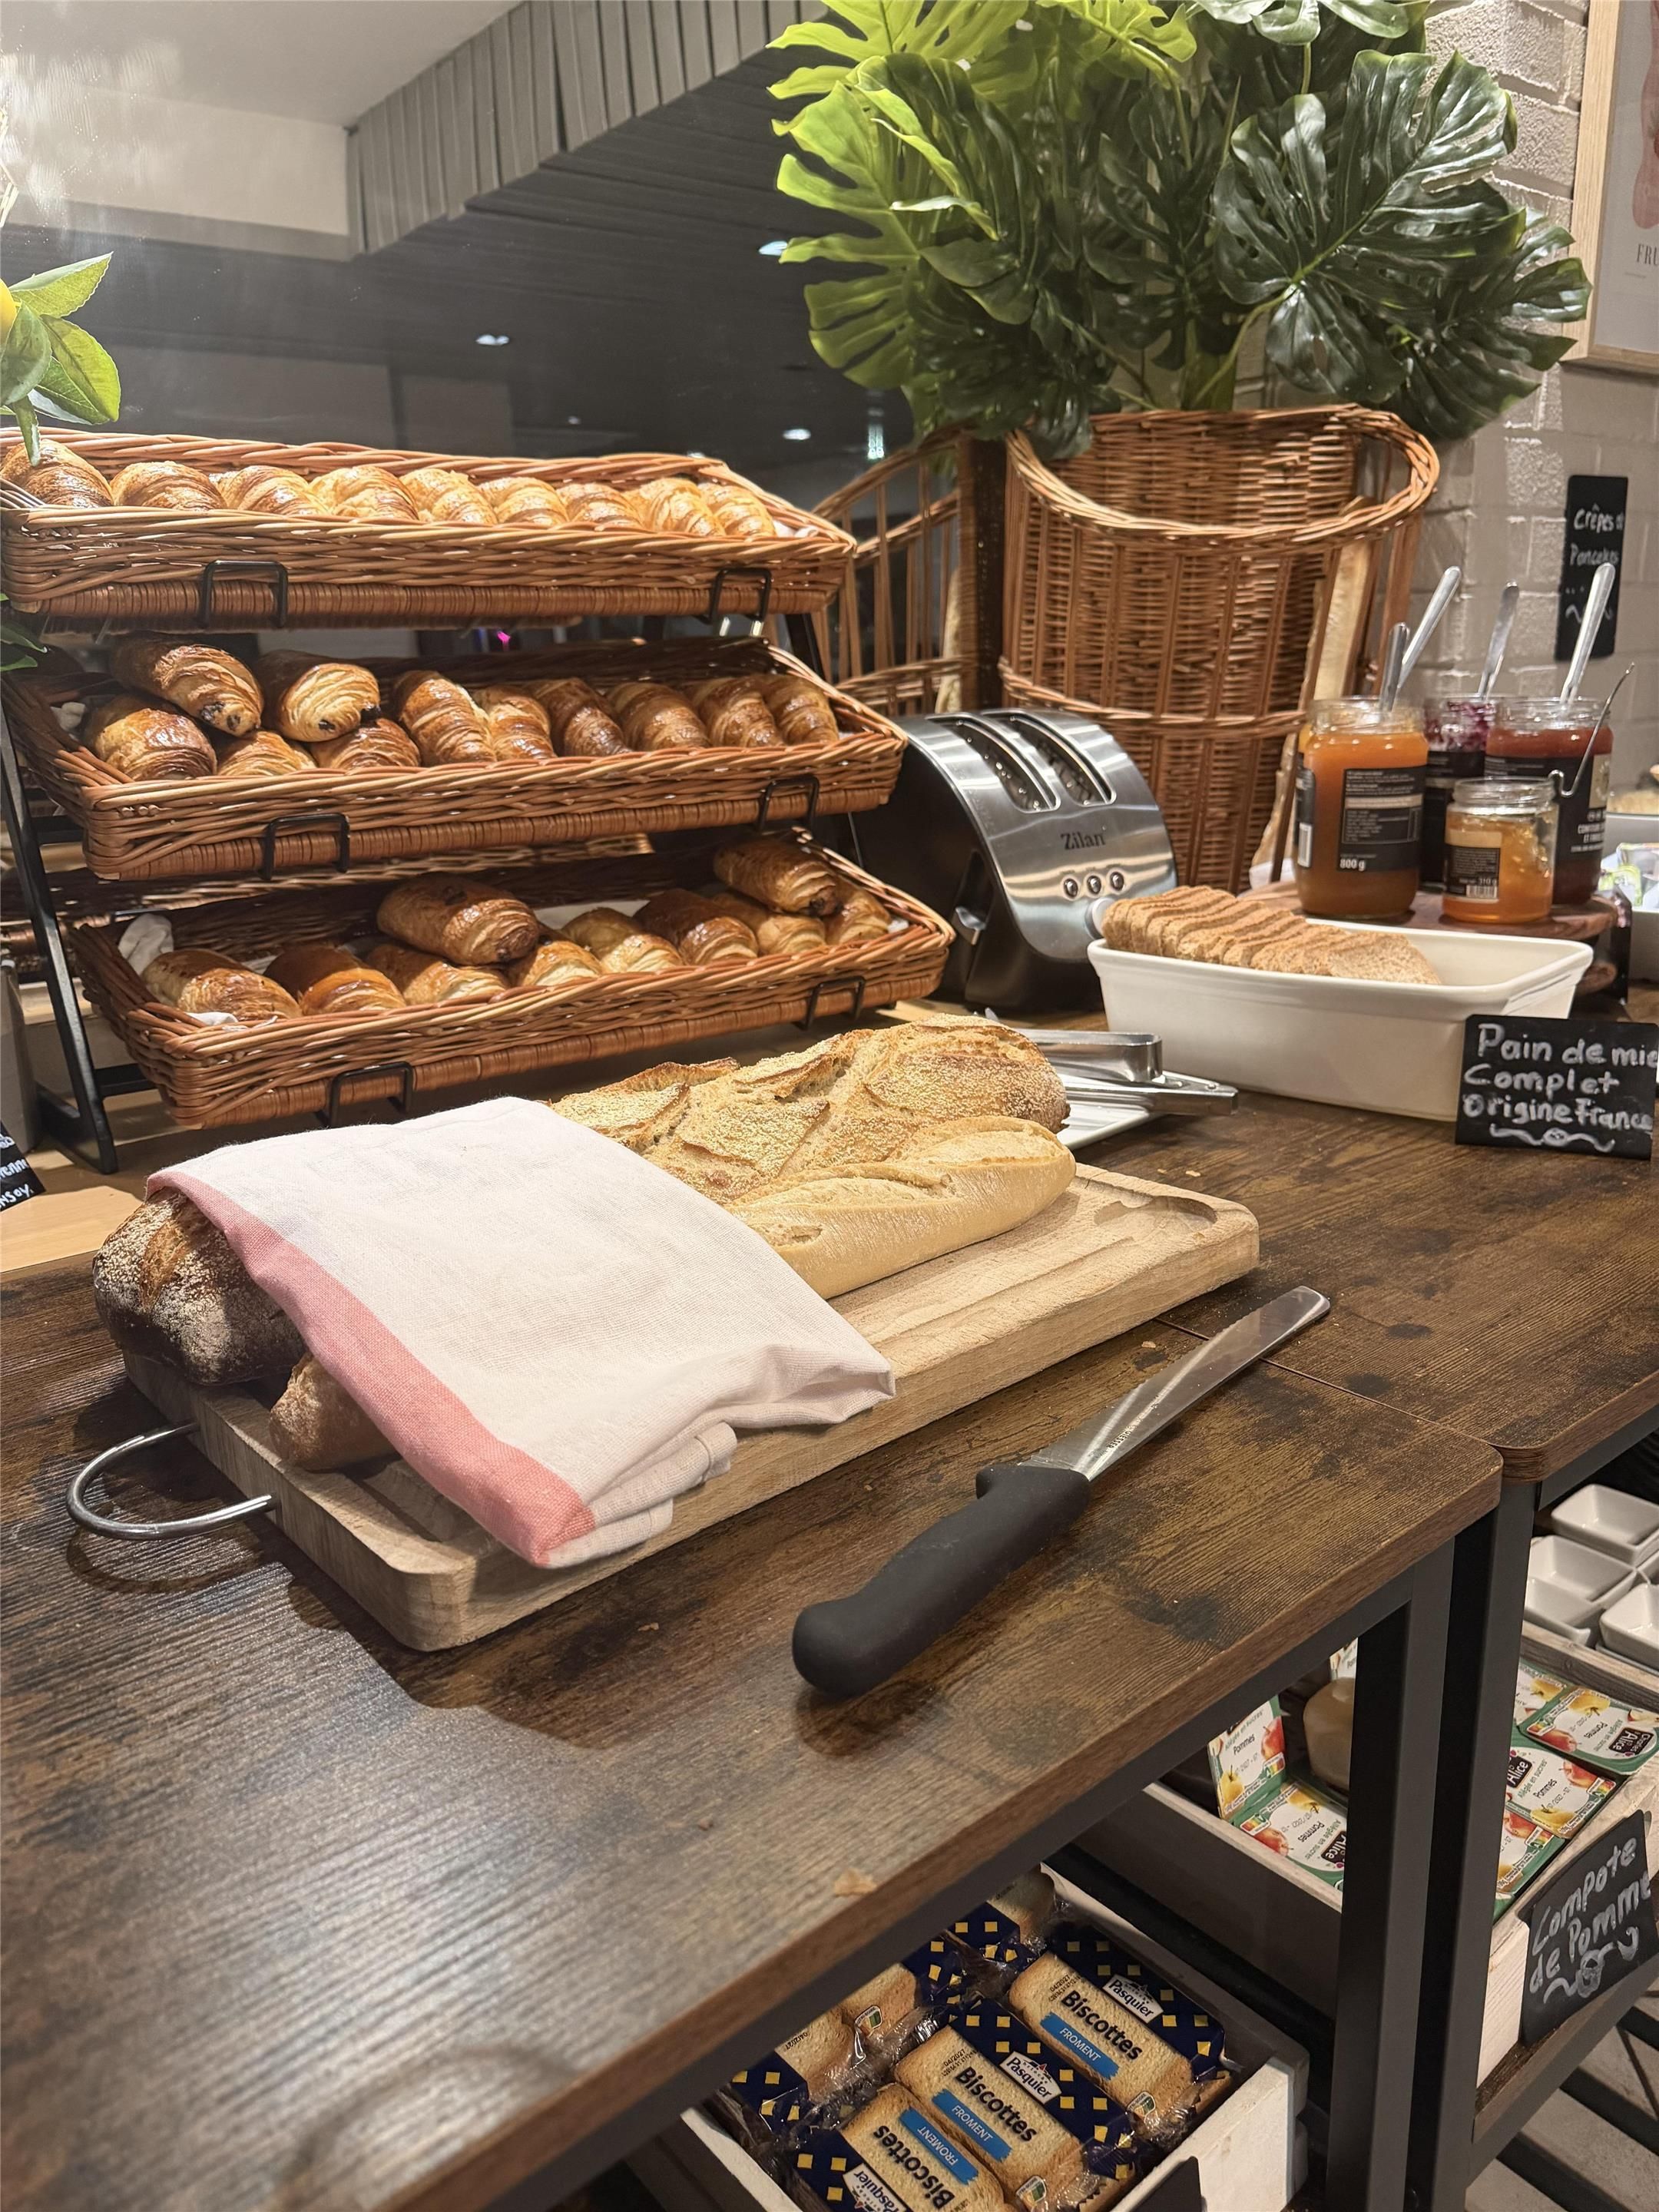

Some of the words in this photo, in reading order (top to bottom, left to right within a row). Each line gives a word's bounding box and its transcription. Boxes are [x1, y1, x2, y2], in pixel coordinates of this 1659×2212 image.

[1060, 831, 1106, 849] Zilan
[1339, 859, 1358, 869] 800
[1359, 860, 1366, 871] g
[1478, 1023, 1553, 1062] Pain
[1561, 1038, 1608, 1065] de
[1611, 1045, 1658, 1068] mie
[1464, 1063, 1620, 1099] Complet
[1462, 1093, 1574, 1124] Origine
[1233, 1734, 1256, 1756] Pommes
[1612, 1730, 1637, 1750] Alice
[1533, 1778, 1558, 1799] Pommes
[1297, 1821, 1325, 1843] Pommes
[1532, 1837, 1637, 1957] Compote
[1529, 1947, 1561, 1994] de
[1108, 1979, 1154, 2018] Pasquier
[1061, 1989, 1143, 2061] Biscottes
[1059, 2027, 1101, 2062] FROMENT
[1006, 2057, 1053, 2098] Pasquier
[952, 2104, 993, 2142] FROMENT
[955, 2066, 1038, 2142] Biscottes
[917, 2126, 959, 2166] FROMENT
[873, 2125, 955, 2210] Biscottes
[854, 2170, 899, 2212] Pasquier
